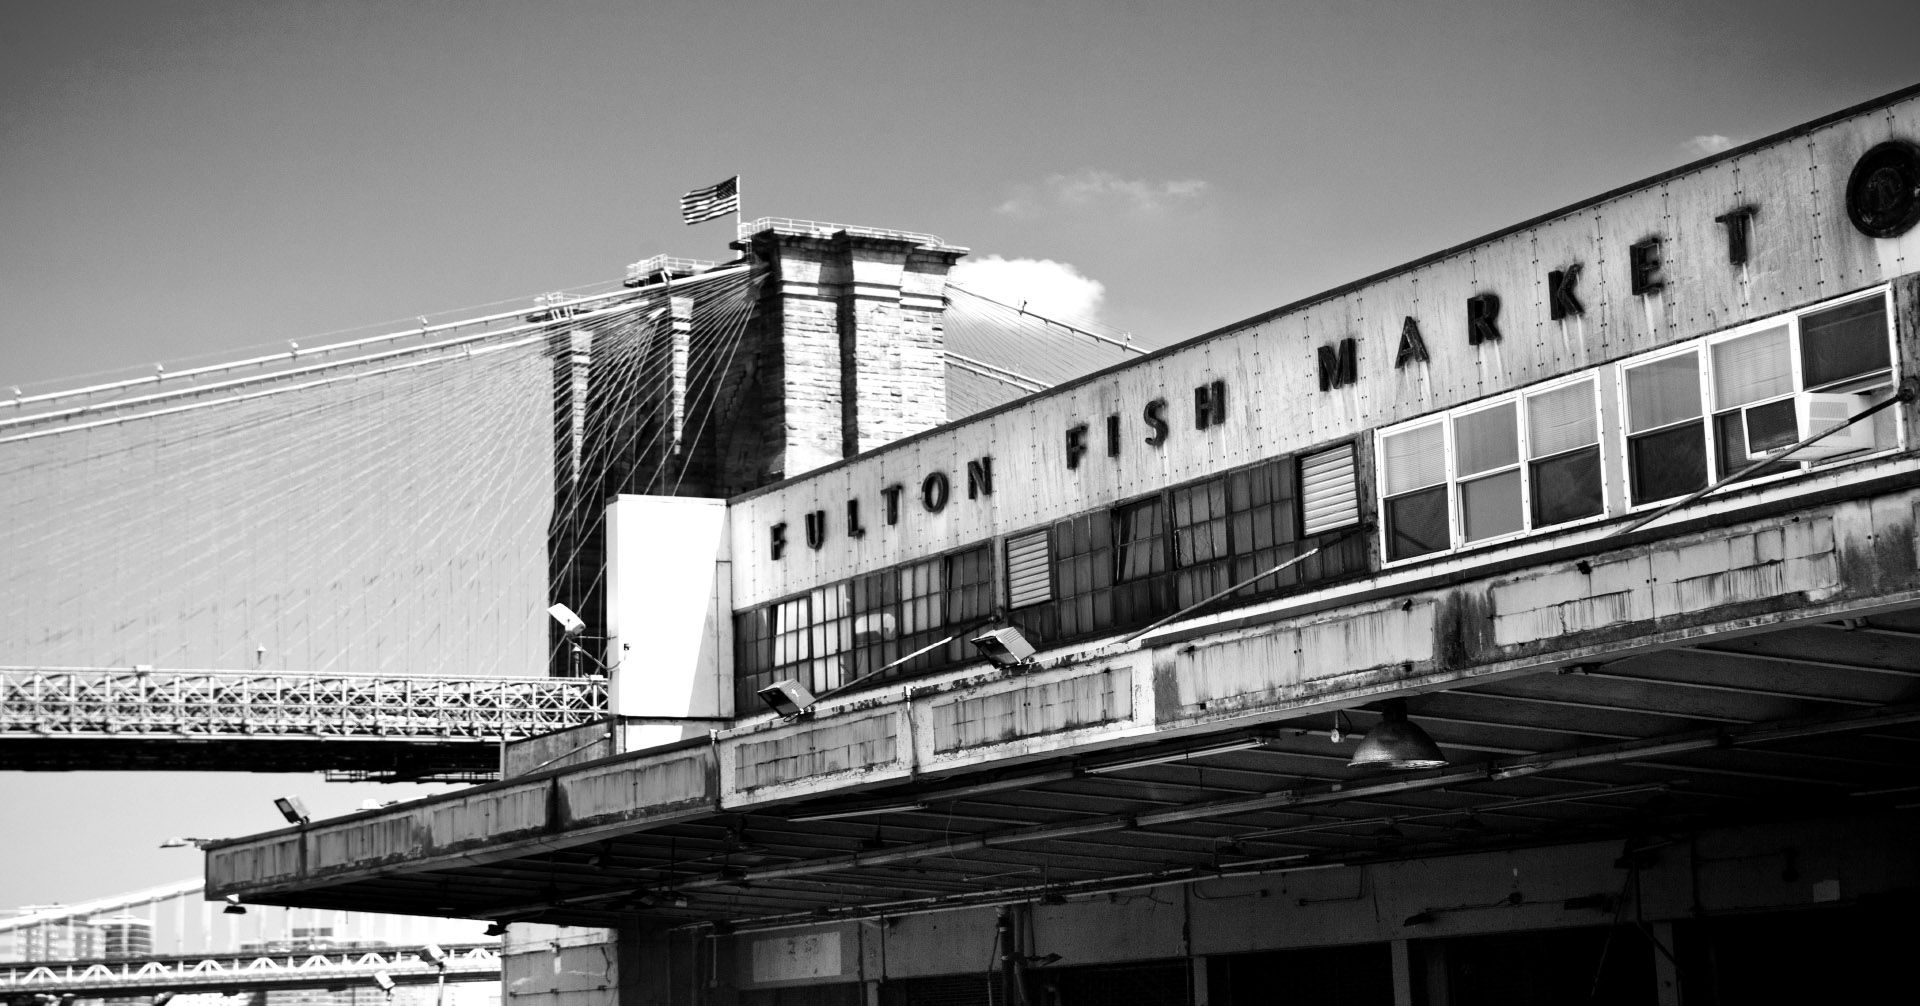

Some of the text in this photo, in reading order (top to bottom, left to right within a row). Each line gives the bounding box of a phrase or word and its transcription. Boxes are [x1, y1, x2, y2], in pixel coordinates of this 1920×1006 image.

[770, 203, 1760, 561] FULTON FISH MARKET
